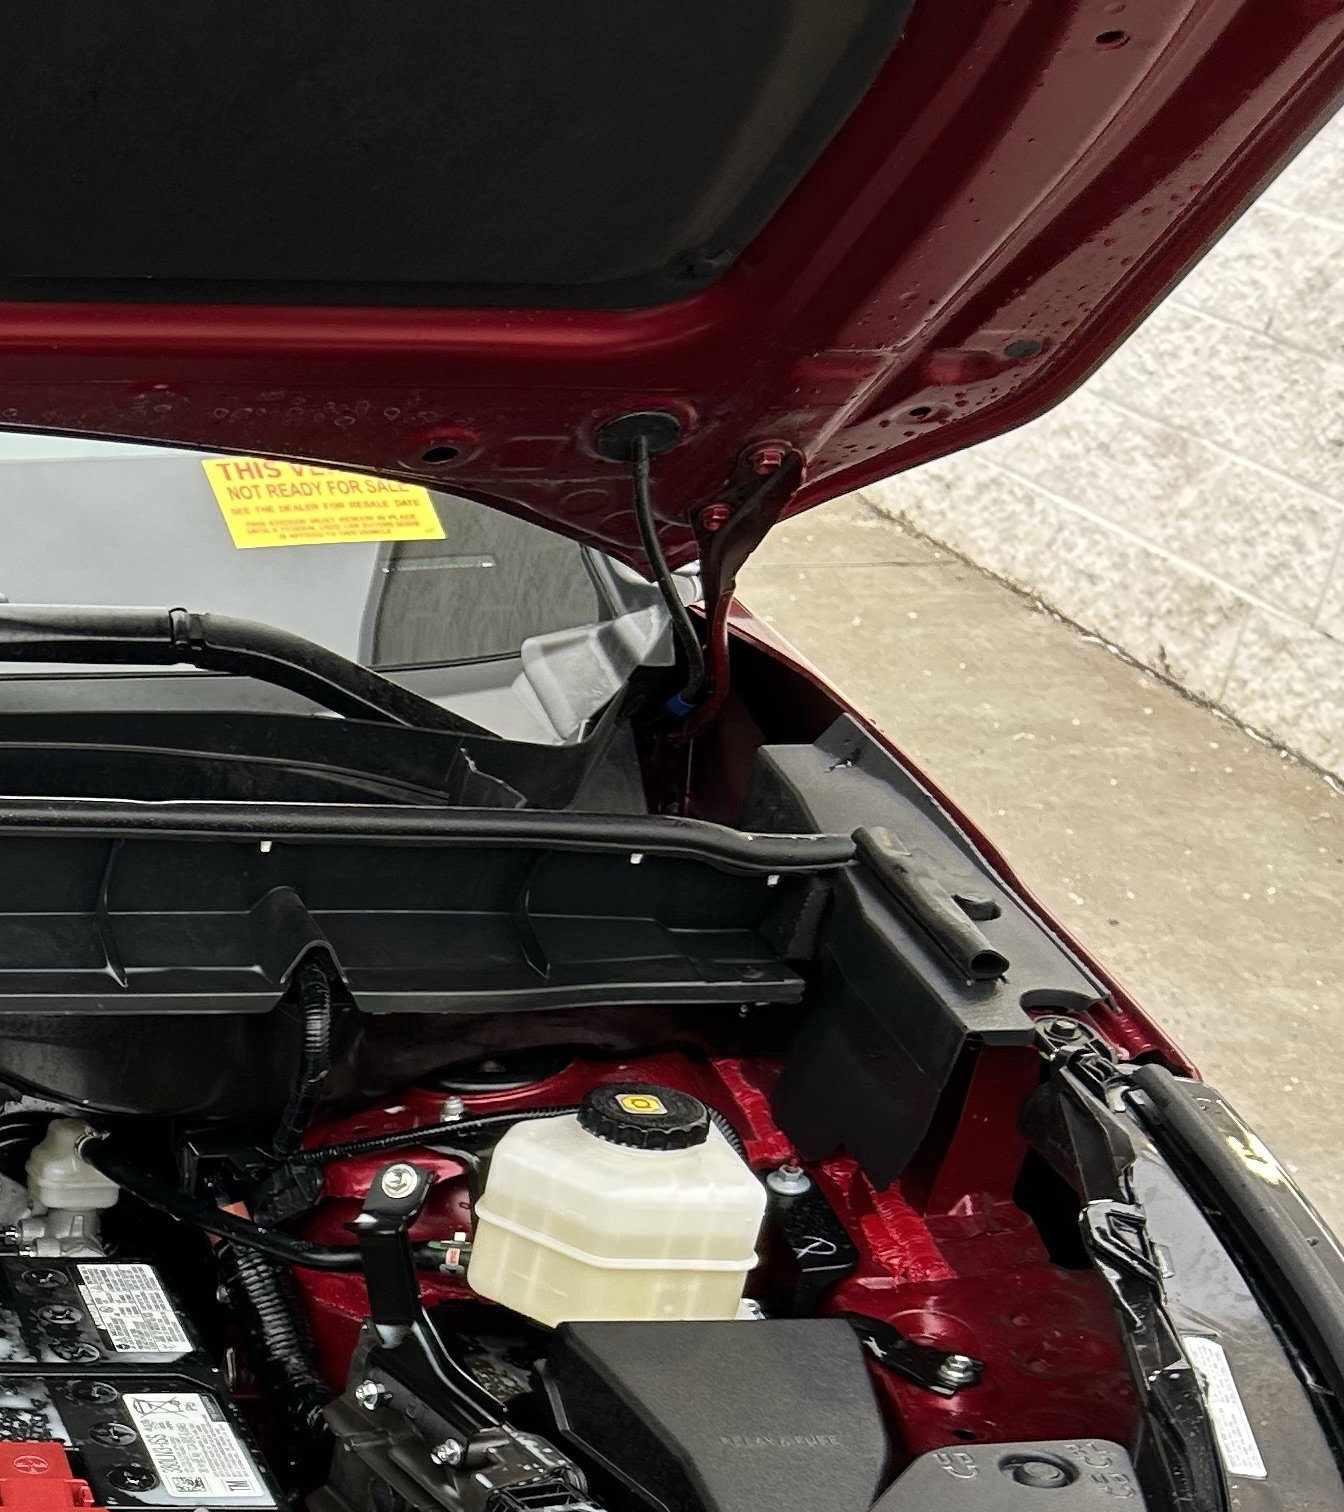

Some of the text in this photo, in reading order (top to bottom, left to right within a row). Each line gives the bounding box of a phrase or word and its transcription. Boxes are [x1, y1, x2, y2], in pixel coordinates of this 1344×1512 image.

[216, 461, 282, 481] THIS
[226, 479, 409, 501] NOT READY FOR SALE
